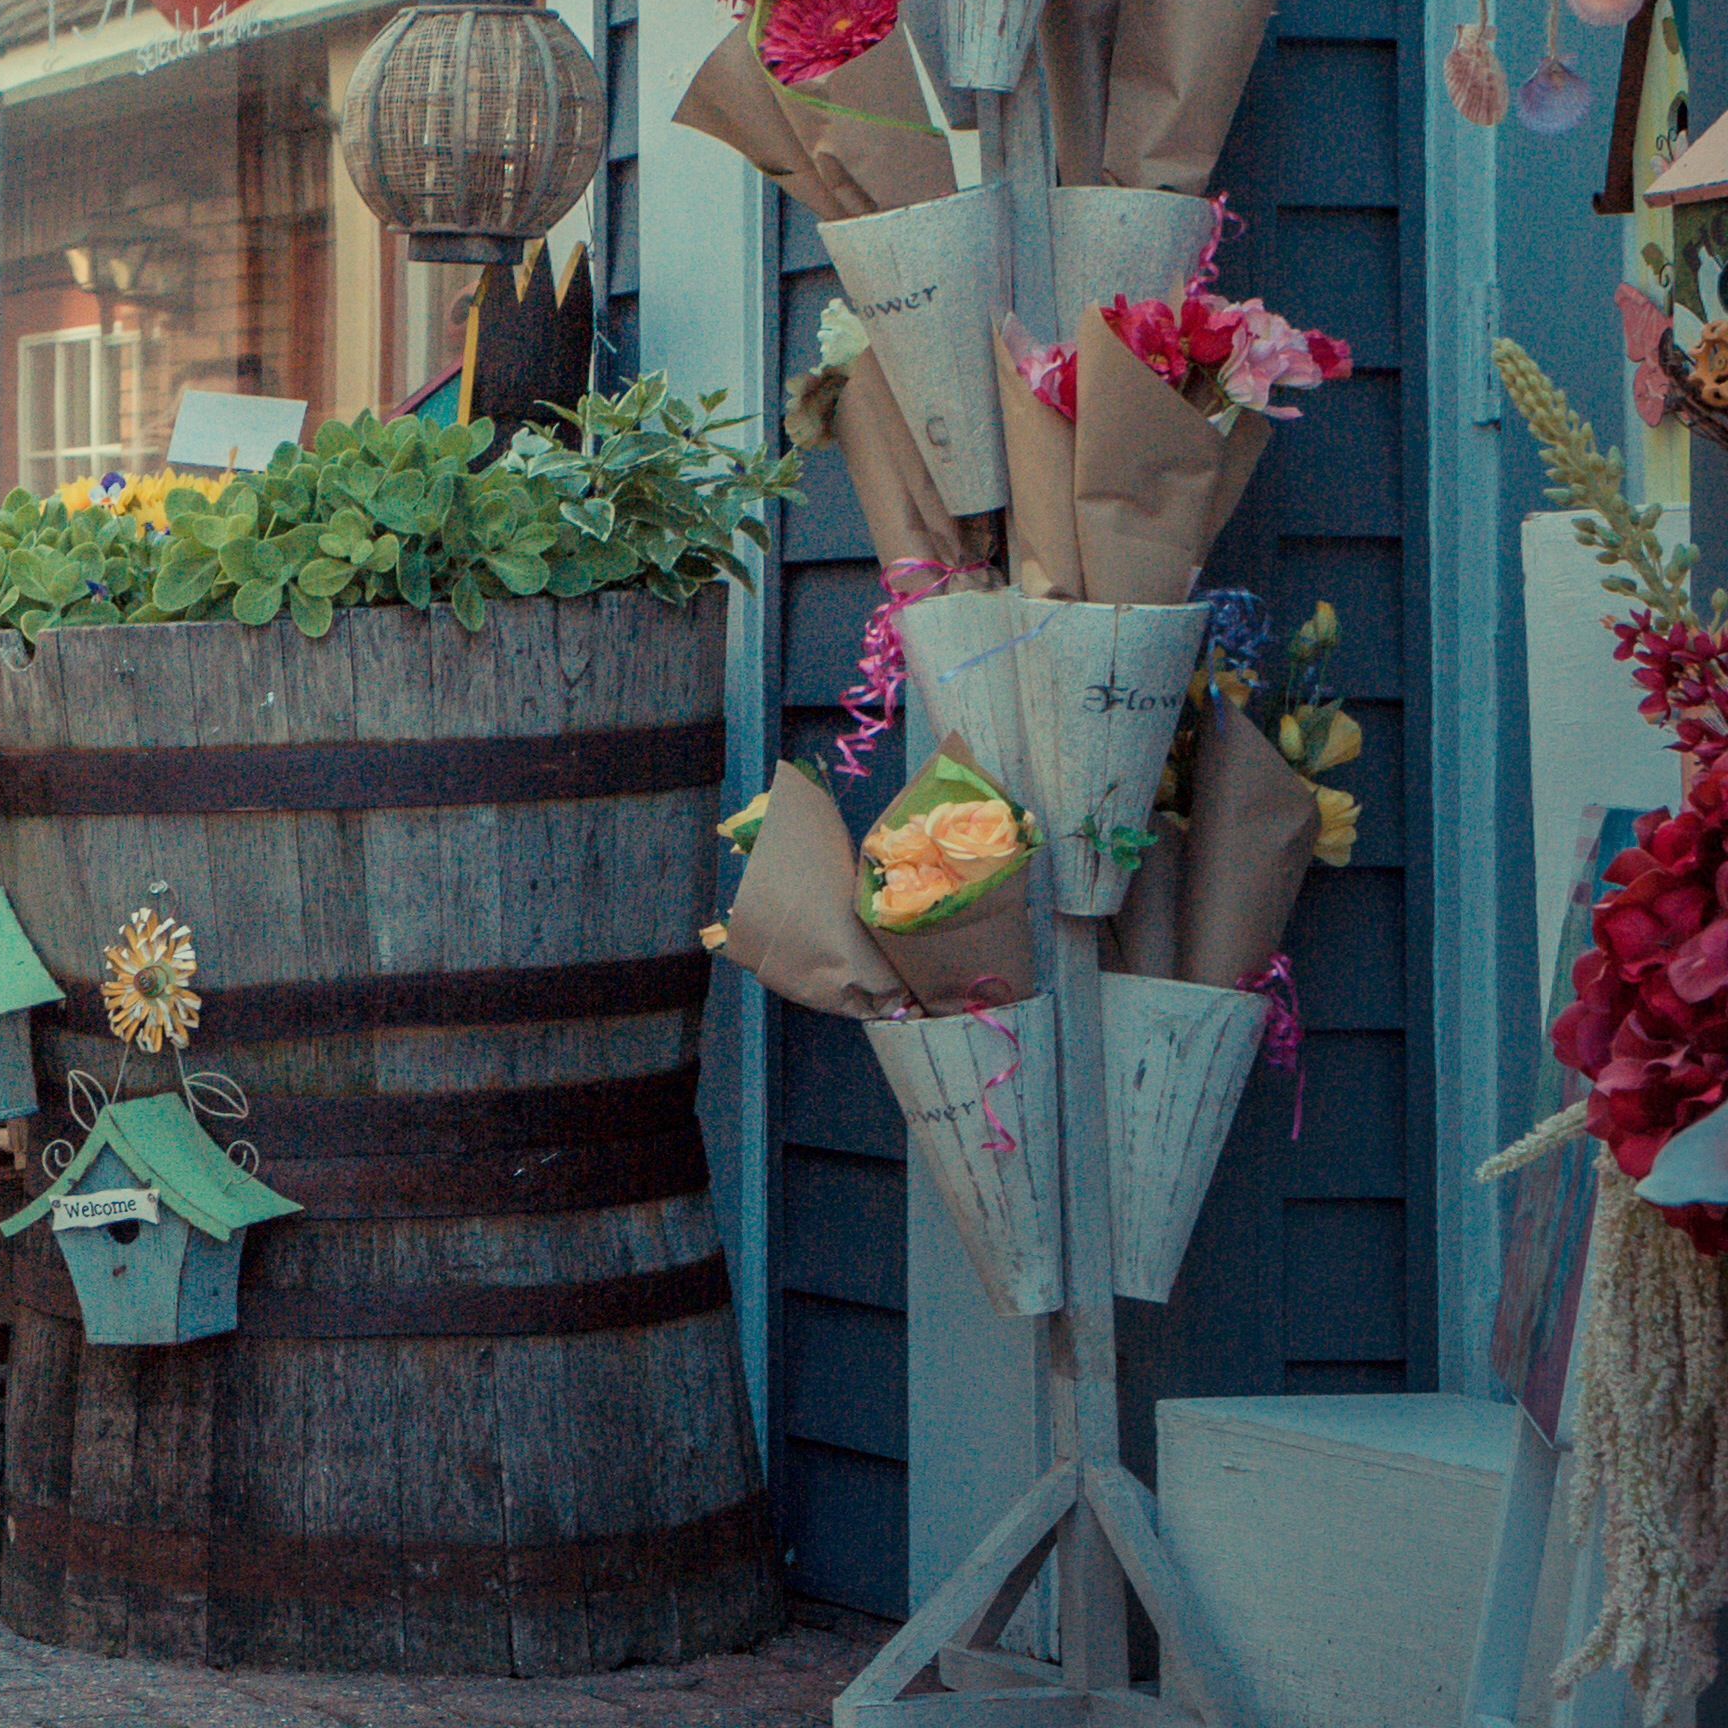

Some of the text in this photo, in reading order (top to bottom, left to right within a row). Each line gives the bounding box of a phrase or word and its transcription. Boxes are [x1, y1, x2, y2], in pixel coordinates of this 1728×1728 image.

[862, 284, 938, 319] ower
[1084, 684, 1184, 713] Flow
[64, 1198, 137, 1218] Welcome
